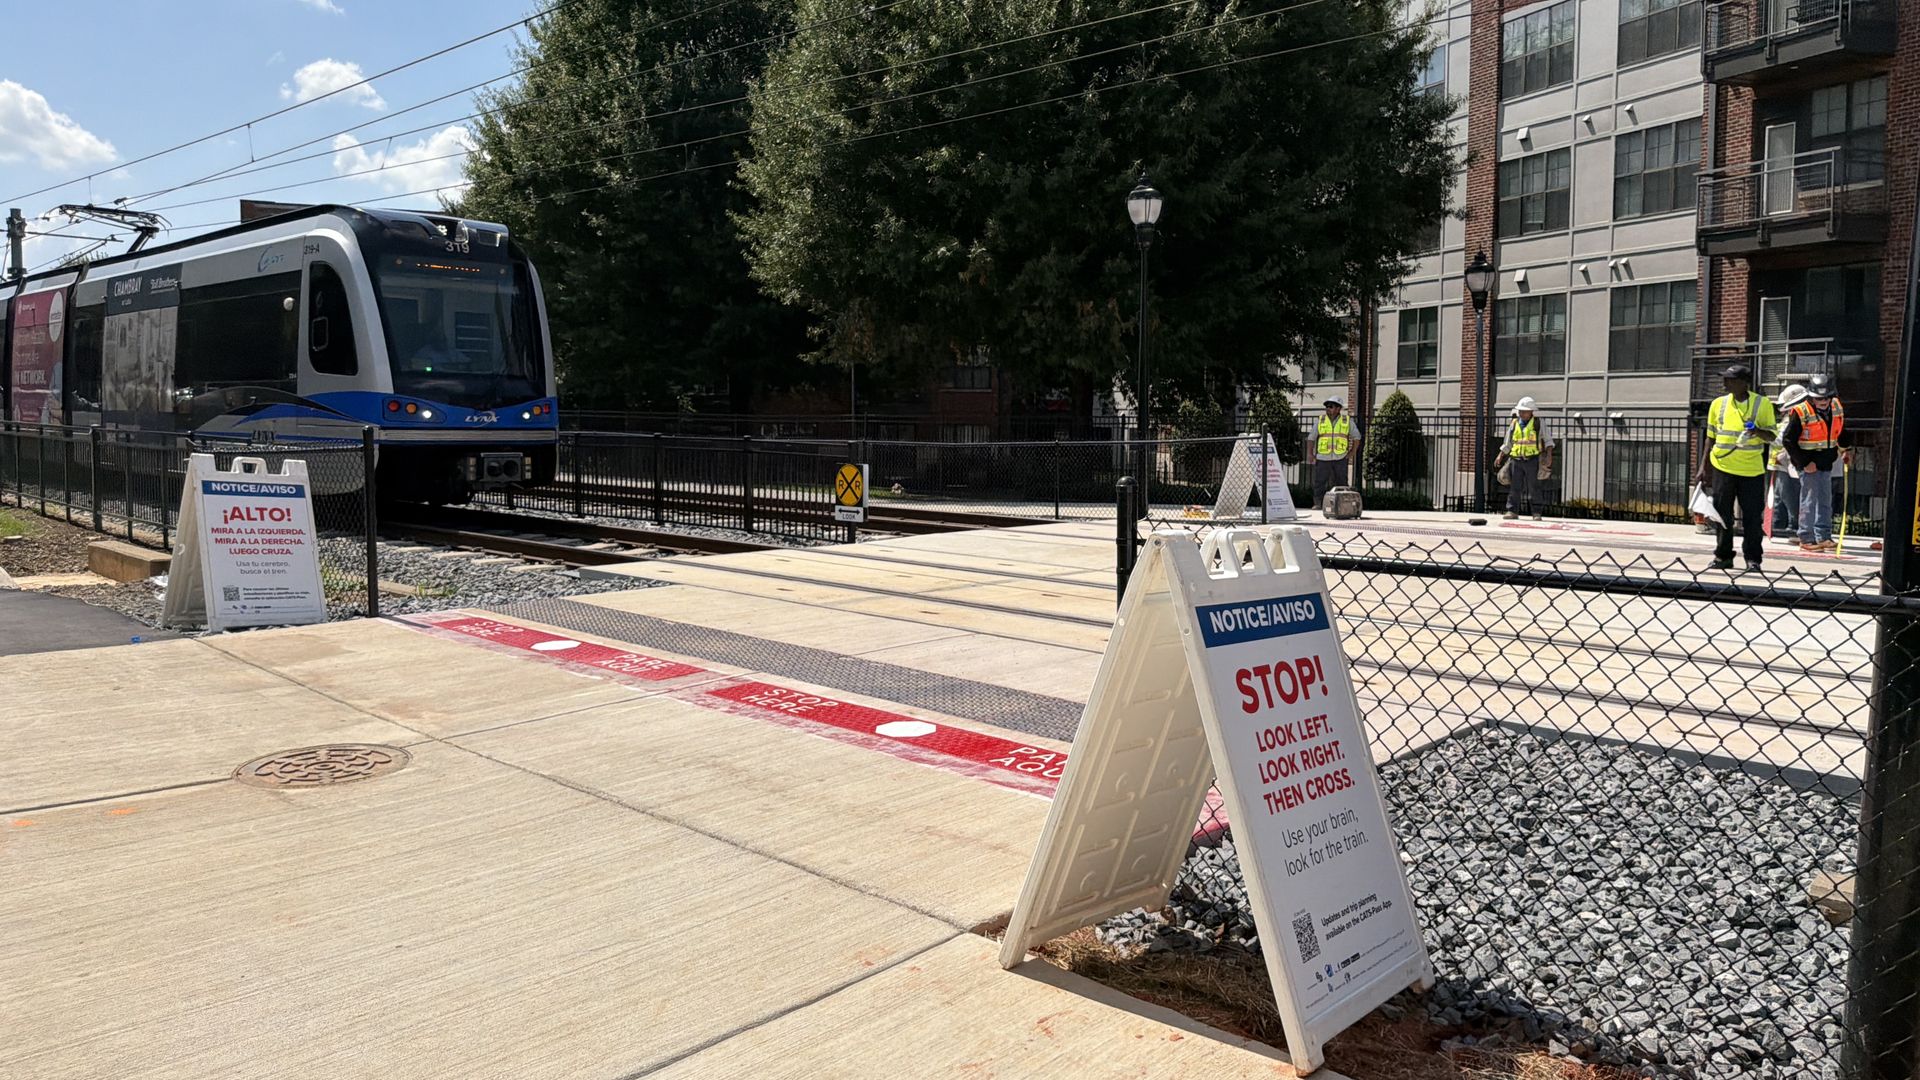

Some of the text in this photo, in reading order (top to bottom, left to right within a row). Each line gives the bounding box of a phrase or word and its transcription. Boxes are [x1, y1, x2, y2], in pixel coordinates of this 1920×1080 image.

[445, 240, 470, 254] 319
[114, 275, 143, 297] CHAMBRAY
[464, 413, 500, 424] LYNX
[211, 482, 296, 494] NOTICE/AVISO
[838, 479, 861, 490] R R
[223, 506, 292, 524] ¡ALTO!
[229, 547, 259, 555] LUEGO
[1209, 599, 1316, 634] NOTICE/AVISO
[453, 624, 502, 637] HERE
[474, 621, 525, 633] STOP
[613, 653, 676, 670] PARE
[1235, 655, 1328, 714] STOP!
[741, 694, 815, 714] HERE
[763, 688, 839, 707] STOP
[1255, 714, 1333, 752] LOOK LEFT.
[1008, 746, 1068, 766] PA
[1258, 740, 1345, 784] LOOK RIGHT.
[988, 756, 1063, 778] AQU
[1263, 767, 1355, 816] THEN CROSS.
[1281, 807, 1359, 848] Use your brain,
[1284, 829, 1369, 877] look for the train.
[1321, 911, 1341, 927] Updates
[1341, 905, 1350, 917] and
[1349, 902, 1359, 912] trip
[1358, 893, 1377, 909] planning
[1325, 924, 1346, 941] available
[1345, 921, 1352, 930] on
[1351, 916, 1360, 926] the
[1359, 905, 1382, 921] CATS-Pass
